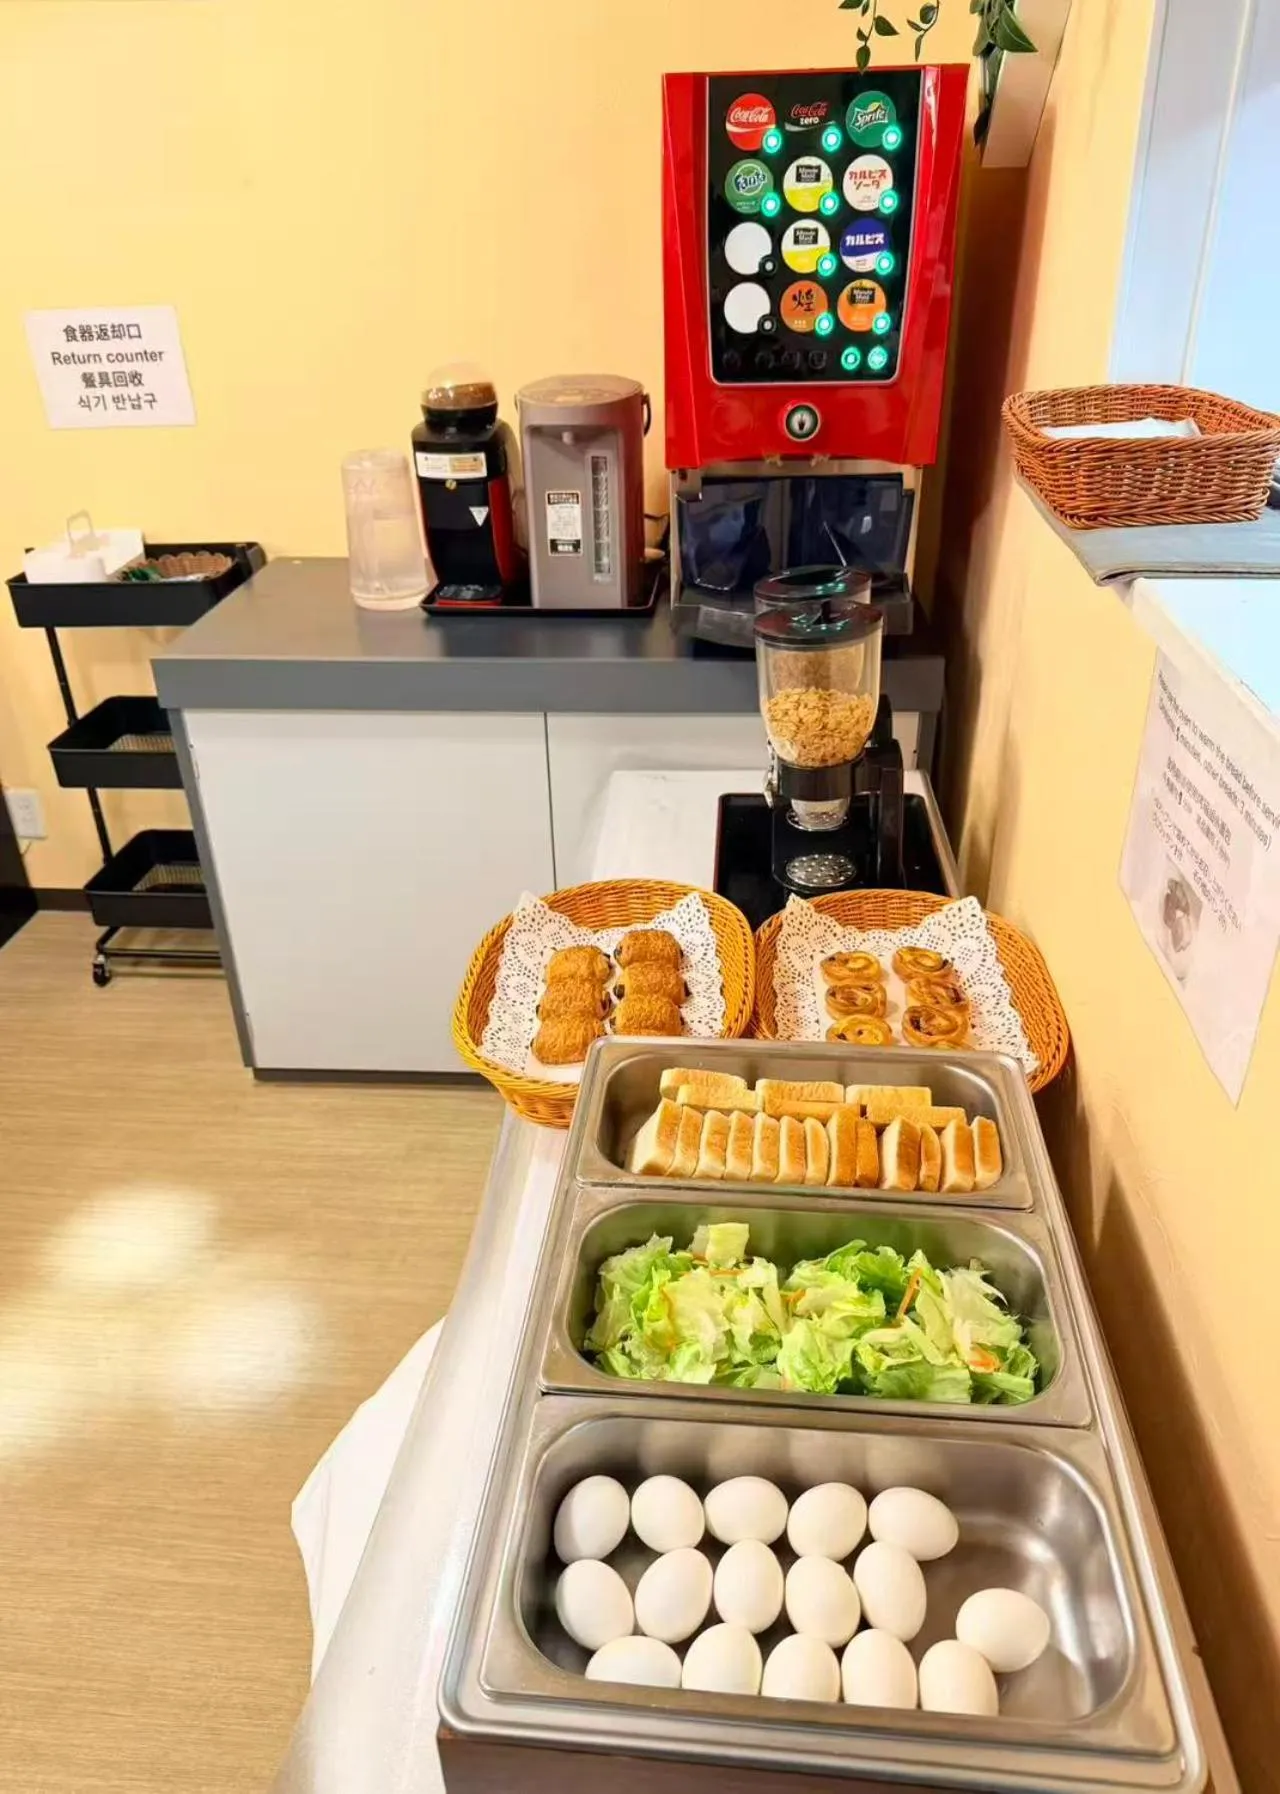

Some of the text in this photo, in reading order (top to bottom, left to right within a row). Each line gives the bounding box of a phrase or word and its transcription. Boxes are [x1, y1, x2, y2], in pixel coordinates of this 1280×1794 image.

[730, 107, 772, 123] Coca-Cola
[799, 116, 820, 125] zero
[855, 109, 885, 127] Sprite
[734, 171, 766, 192] Fanta
[63, 323, 142, 343] 食器返却口
[50, 349, 164, 366] Return counter
[81, 370, 144, 389] 餐具回收
[78, 392, 158, 412] 식기 반납구
